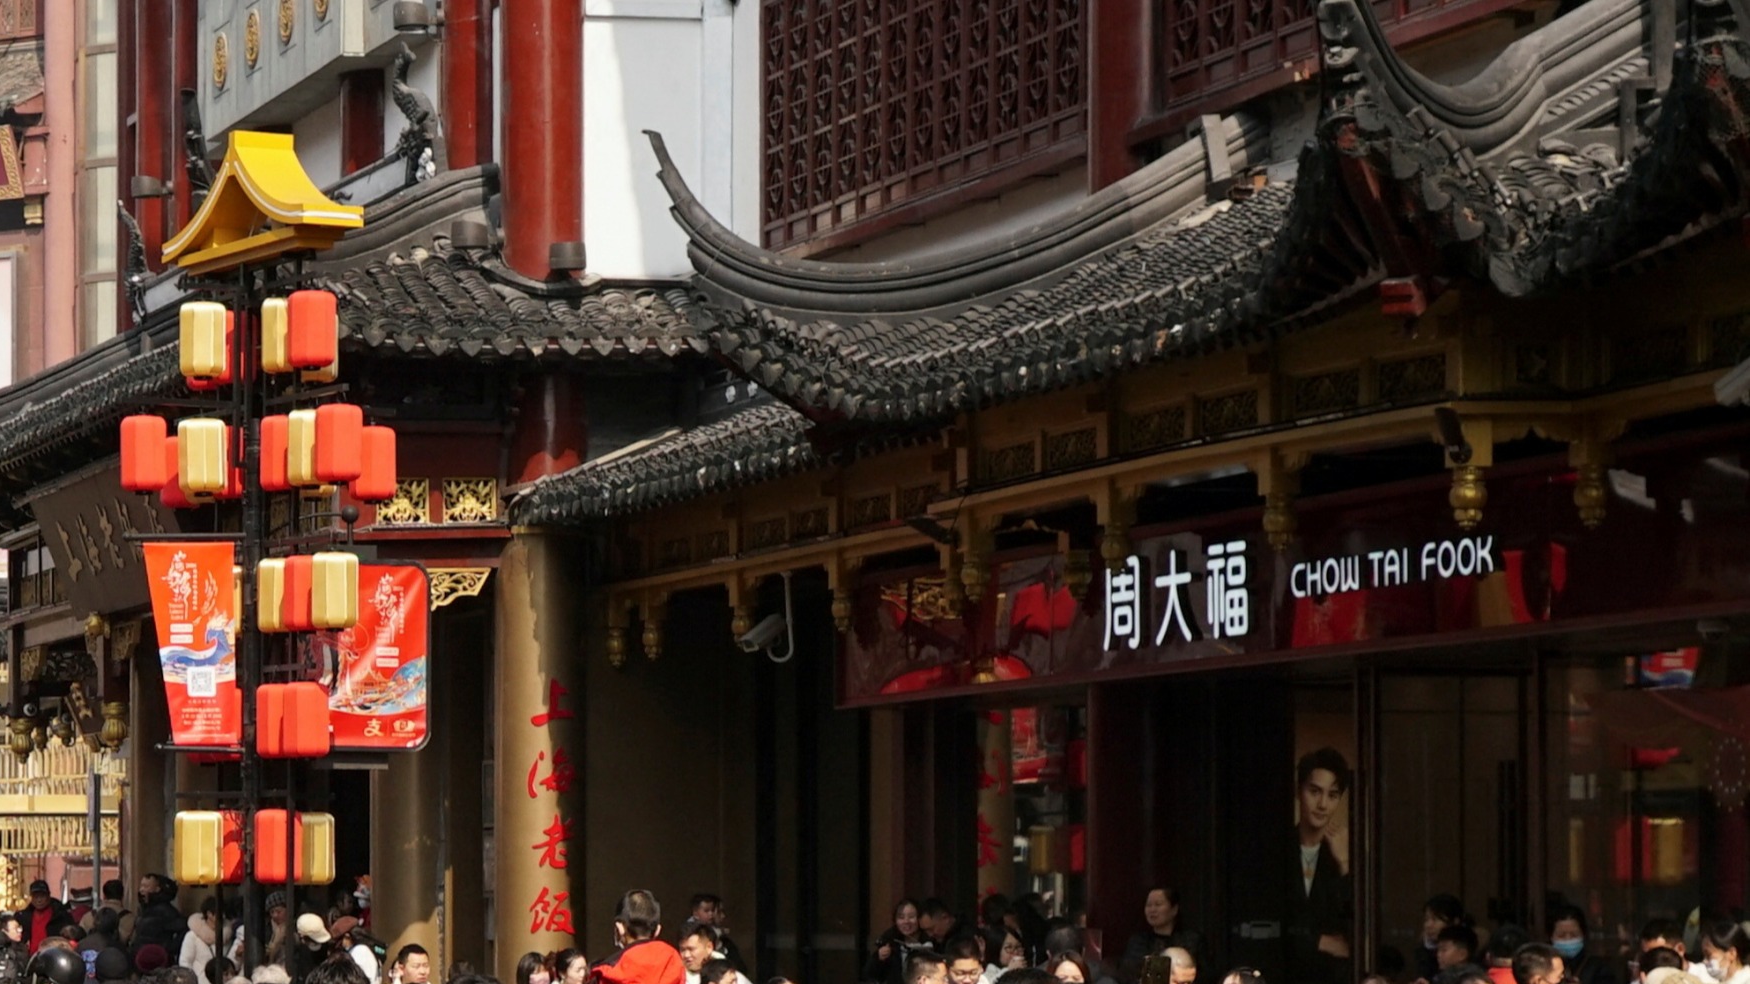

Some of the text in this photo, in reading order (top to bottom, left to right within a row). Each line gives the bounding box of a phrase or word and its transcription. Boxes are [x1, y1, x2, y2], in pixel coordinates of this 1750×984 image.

[1103, 539, 1250, 652] 周大福
[1290, 535, 1495, 599] CHOW TAI FOOK
